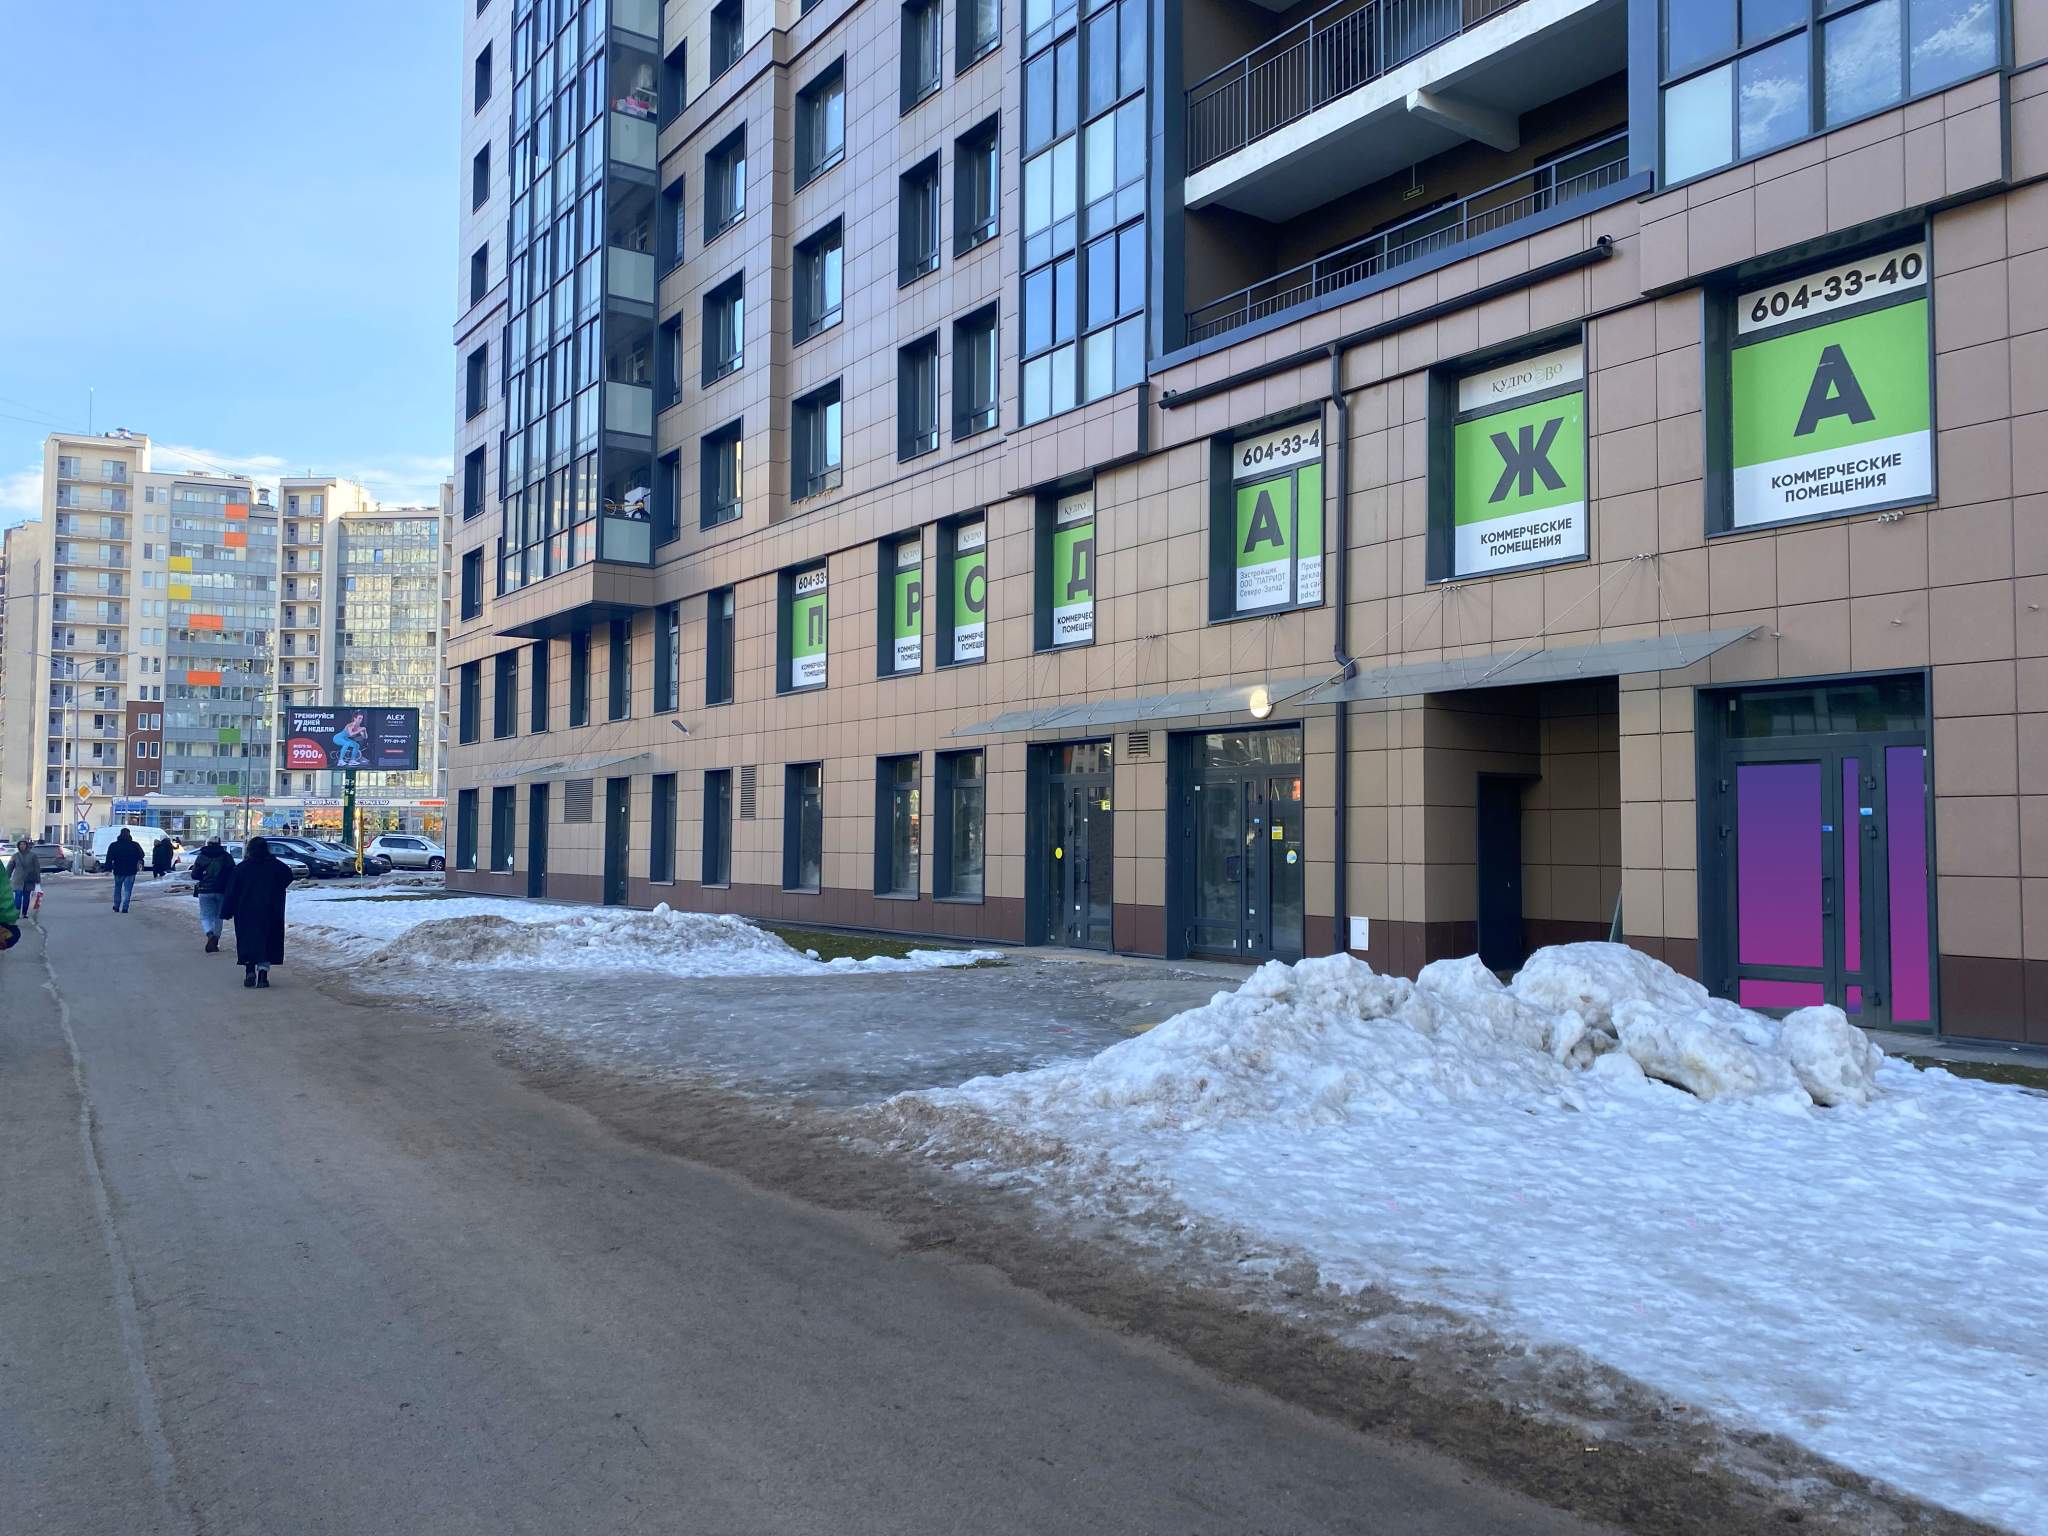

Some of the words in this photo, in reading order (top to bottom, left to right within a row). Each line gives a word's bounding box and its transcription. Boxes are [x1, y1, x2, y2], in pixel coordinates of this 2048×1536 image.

[1751, 253, 1923, 323] 604-33-40
[1793, 343, 1876, 437] А
[1243, 429, 1320, 467] 604-33-4
[1488, 416, 1567, 504] Ж
[1771, 453, 1902, 489] КОММЕРЧЕСКИЕ
[1785, 473, 1887, 503] ПОМЕЩЕНИЯ
[1242, 490, 1285, 553] А
[1480, 518, 1572, 545] КОММЕРЧЕСКИЕ
[1490, 534, 1562, 557] ПОМЕЩЕНИЯ
[1067, 538, 1093, 601] Д
[907, 581, 921, 627] Р
[808, 604, 824, 647] П
[293, 719, 303, 732] 7
[294, 712, 335, 720] ТРЕНИРУЙСЯ
